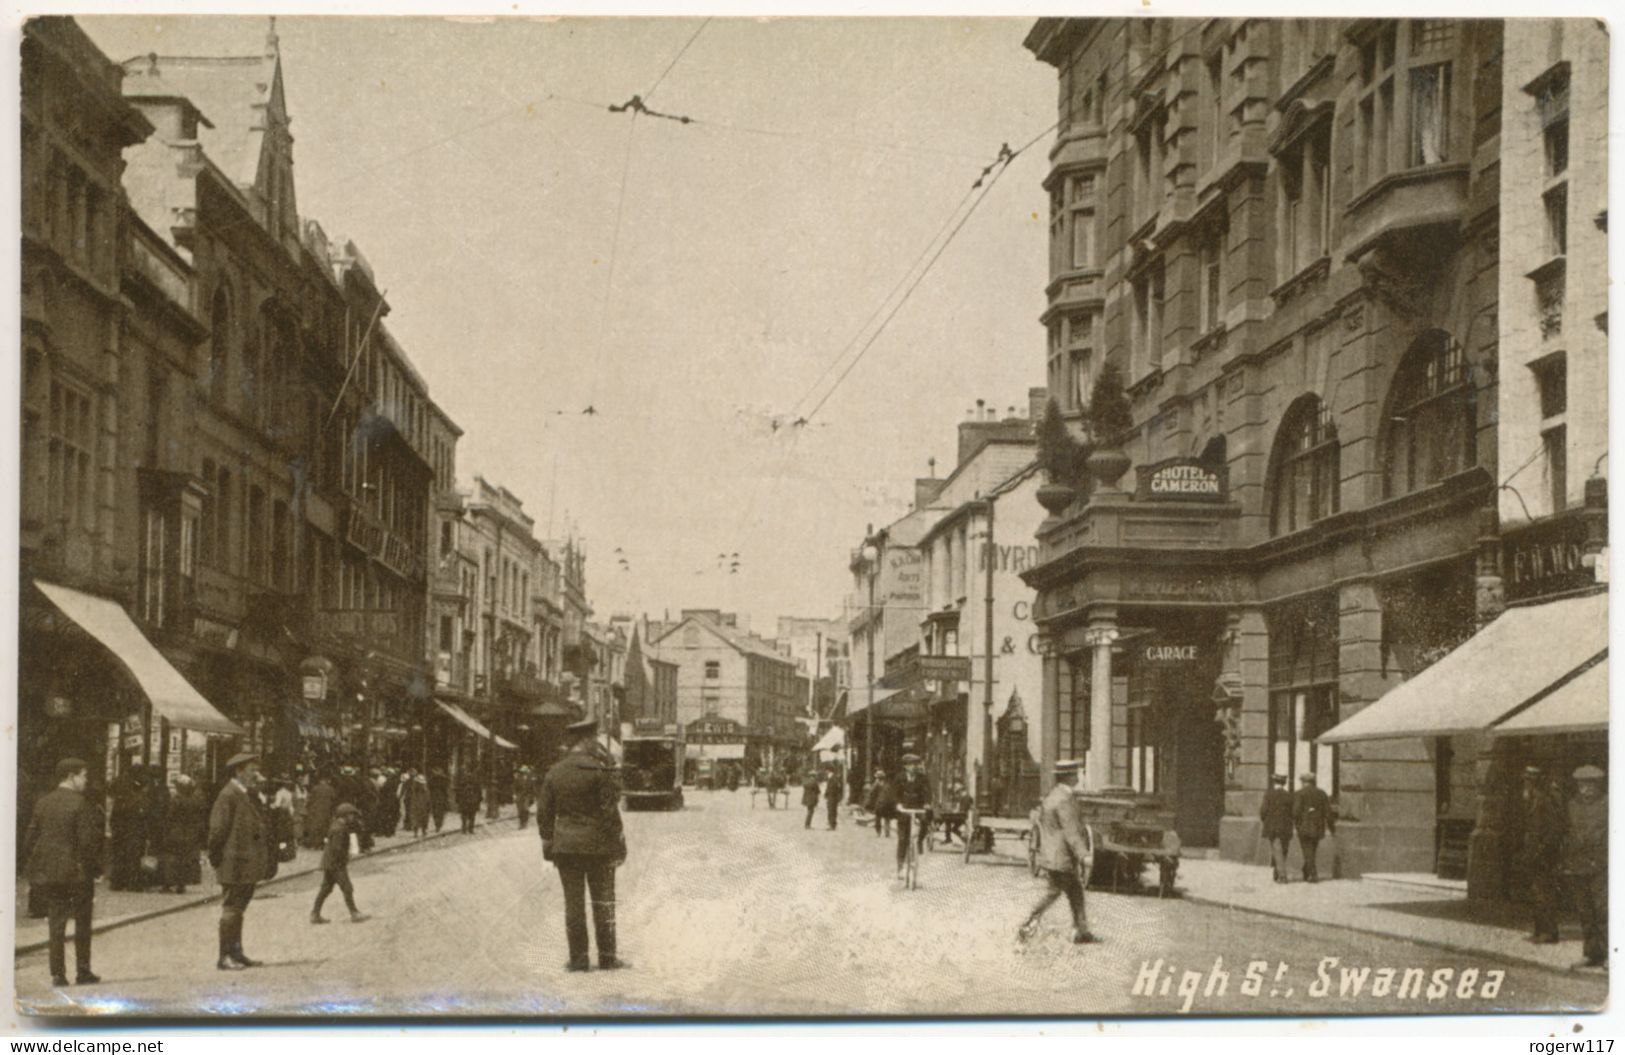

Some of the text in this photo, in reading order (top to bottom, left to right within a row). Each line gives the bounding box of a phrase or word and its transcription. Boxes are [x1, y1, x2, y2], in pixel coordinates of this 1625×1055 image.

[1161, 465, 1207, 480] HOTEL
[1151, 478, 1219, 493] CAMERON
[1146, 645, 1198, 661] GARAGE
